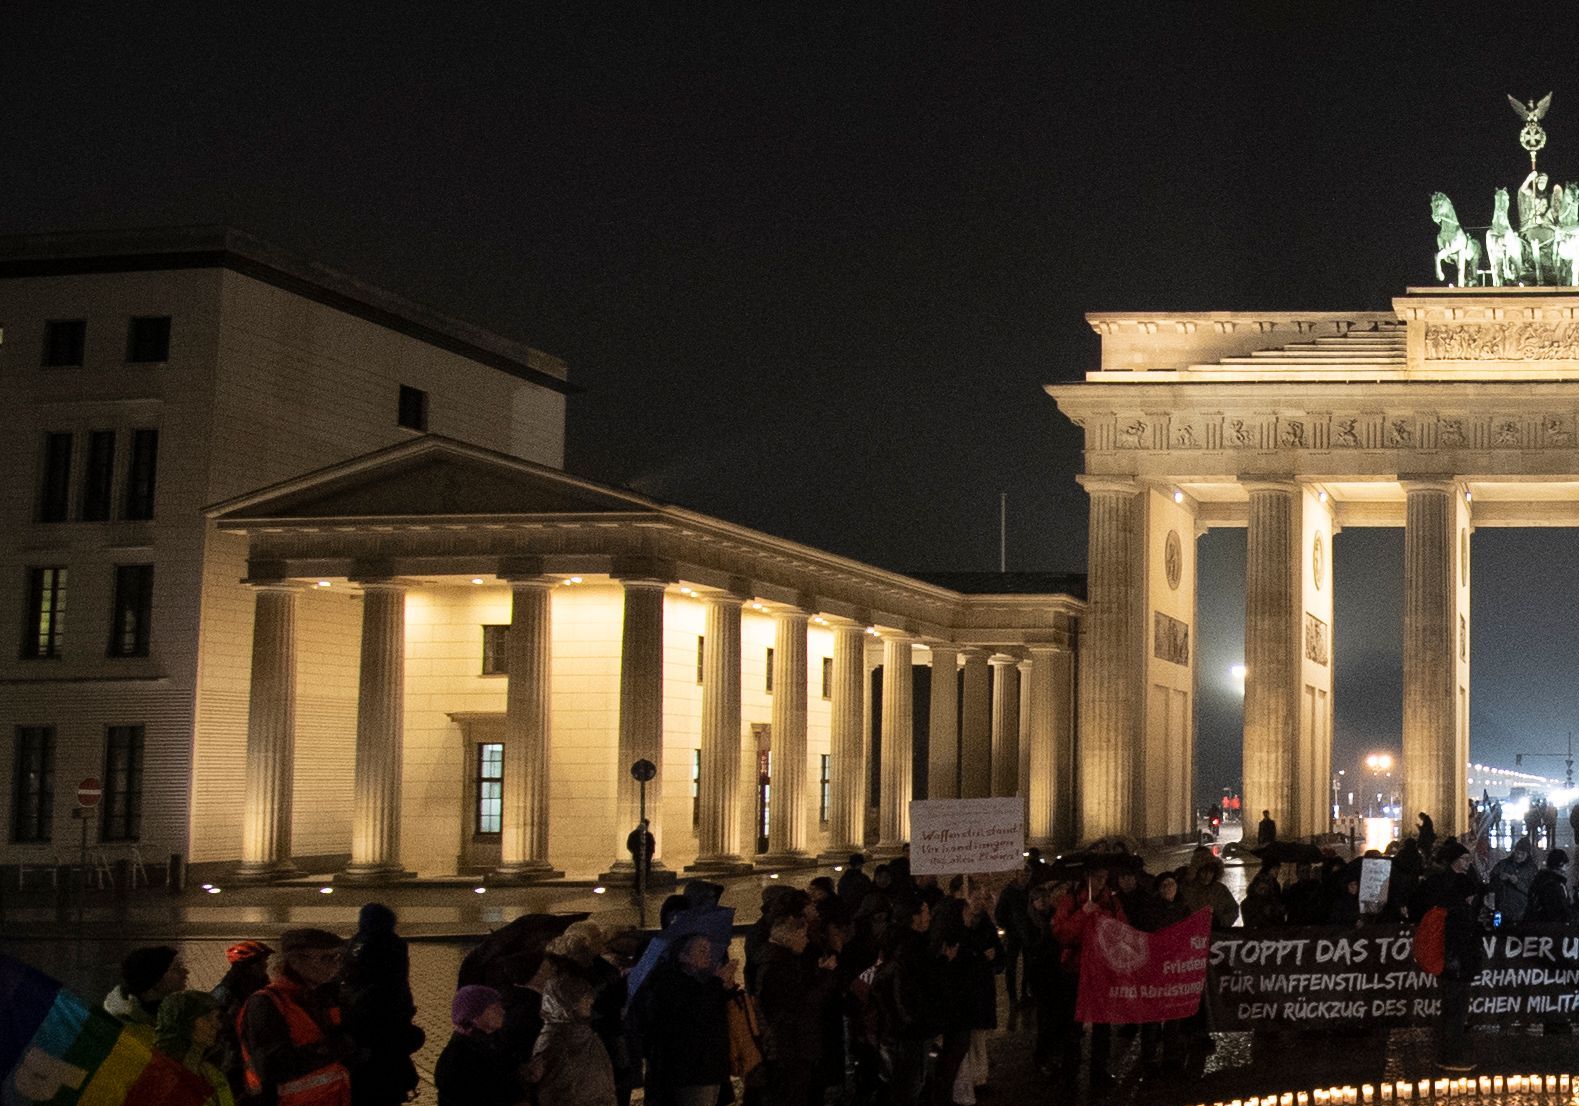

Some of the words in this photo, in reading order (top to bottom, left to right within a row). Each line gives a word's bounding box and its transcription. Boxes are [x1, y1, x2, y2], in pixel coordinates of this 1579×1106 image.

[1209, 938, 1310, 967] STOPPT
[1315, 938, 1369, 965] DAS
[1505, 935, 1556, 962] DER
[1109, 985, 1137, 1000] und
[1219, 970, 1255, 994] FÜR
[1259, 971, 1439, 993] WAFFENSTILLSTAN
[1237, 1002, 1278, 1020] DEN
[1283, 997, 1368, 1021] RÜCKZUG
[1372, 999, 1409, 1017] DES
